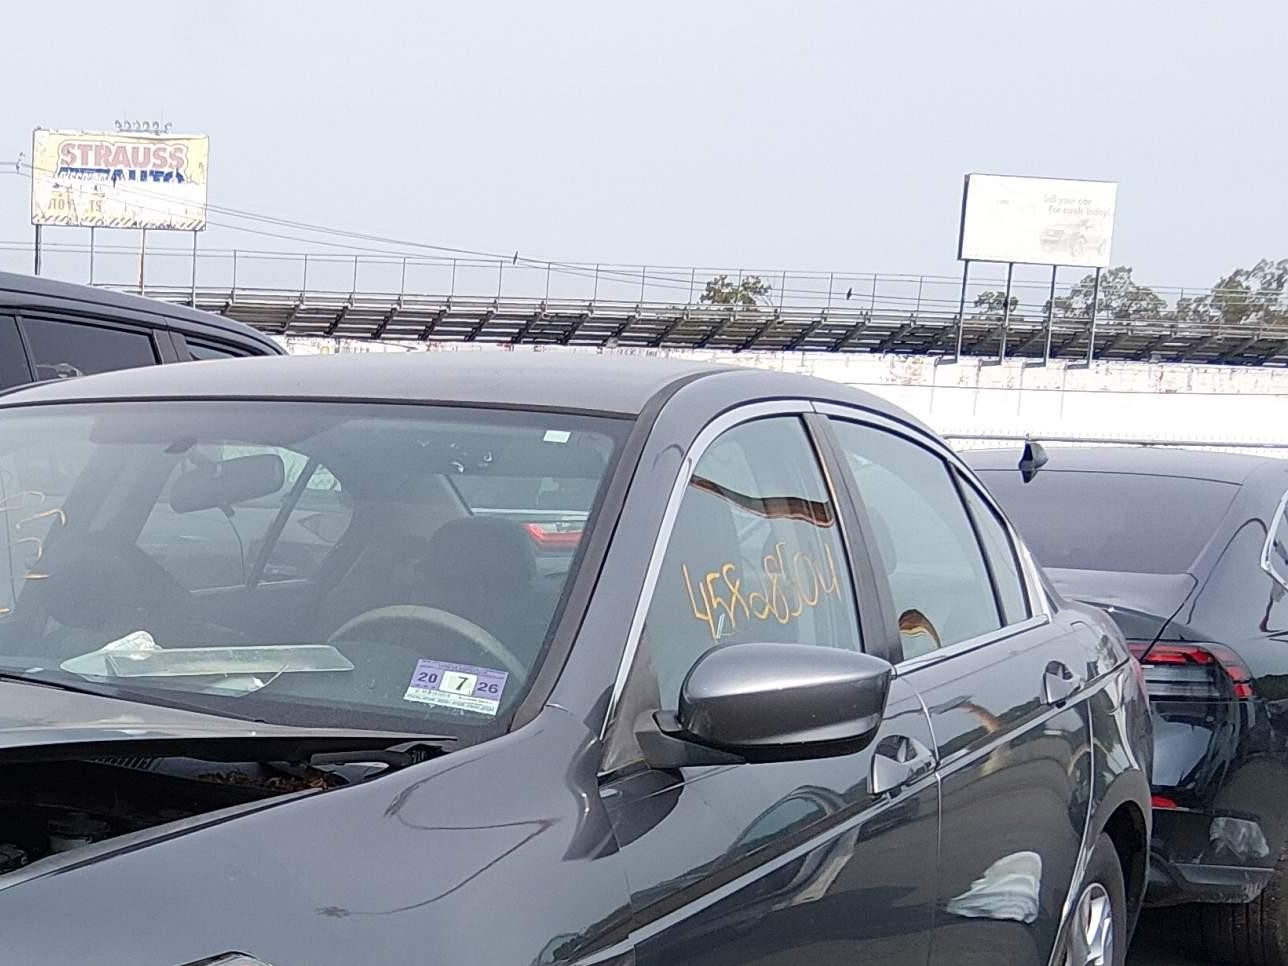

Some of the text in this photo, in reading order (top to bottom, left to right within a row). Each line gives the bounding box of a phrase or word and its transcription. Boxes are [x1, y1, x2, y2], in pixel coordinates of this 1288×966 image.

[61, 143, 185, 169] STRAUSS
[417, 672, 498, 694] 20 7 26
